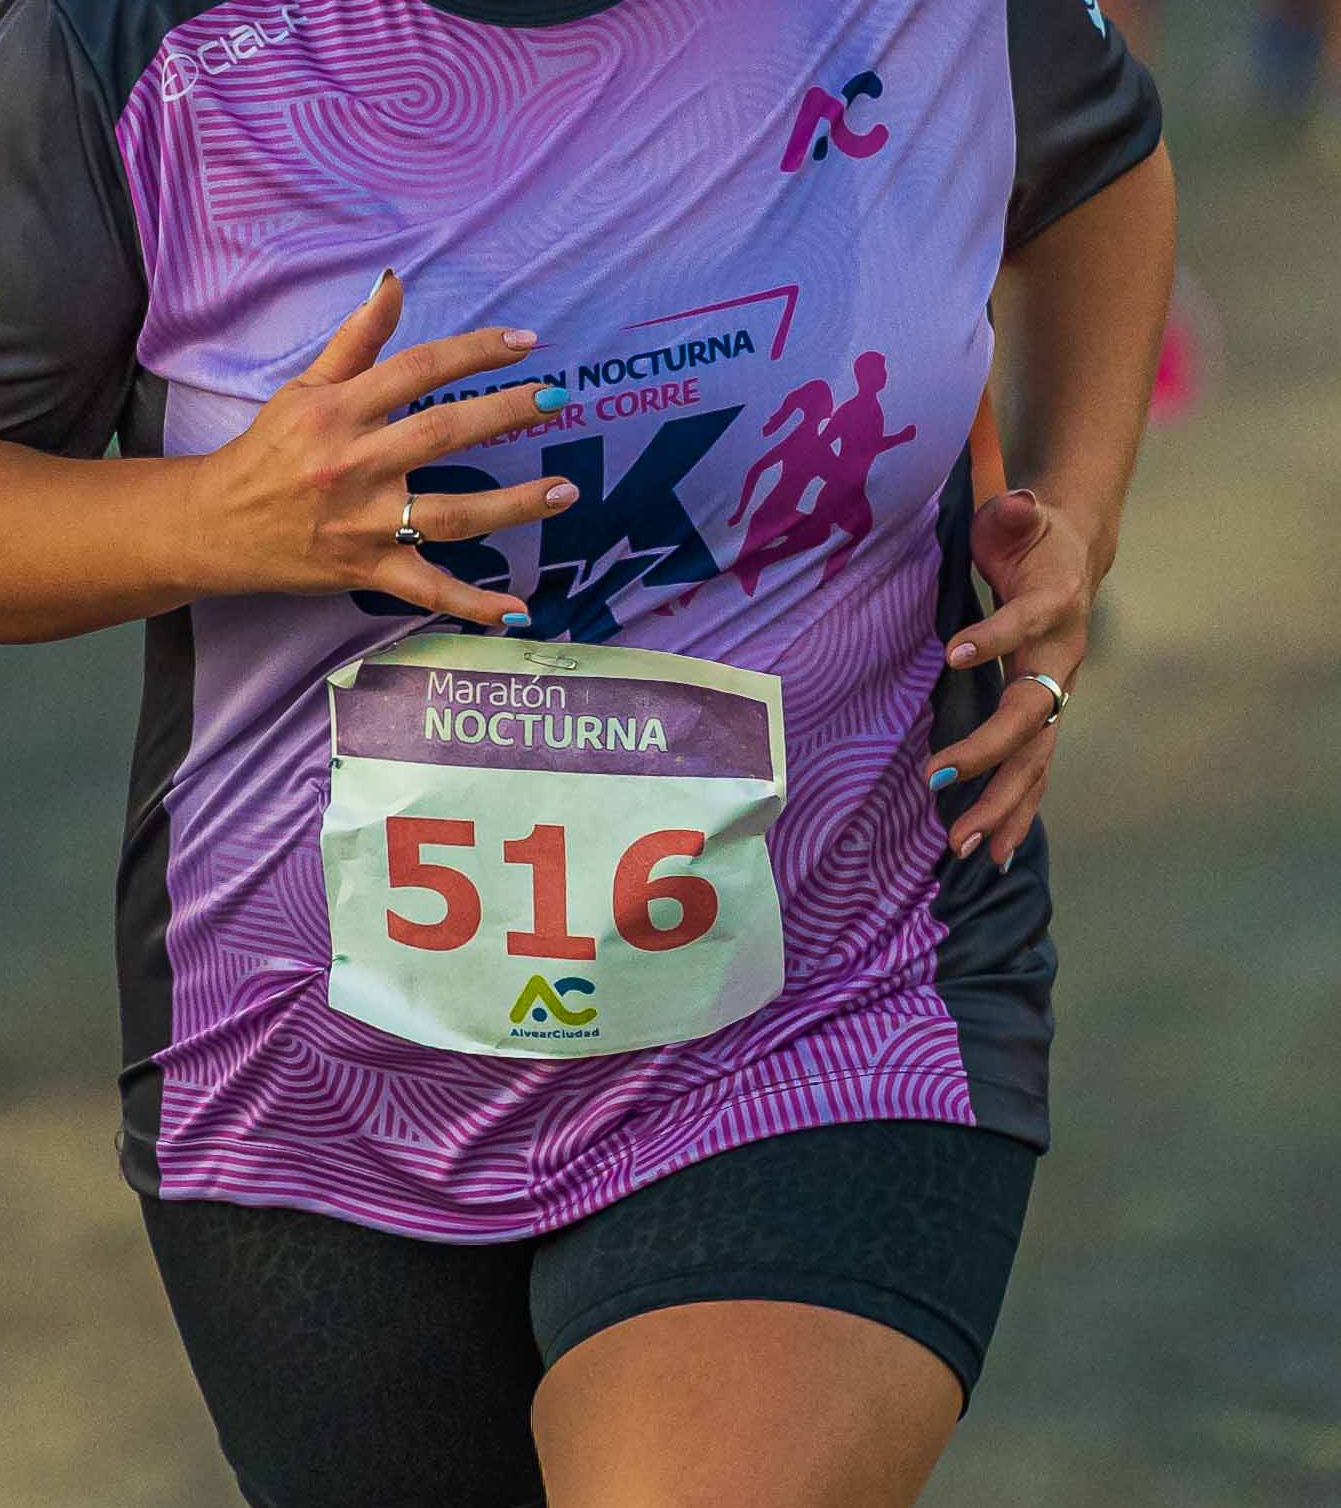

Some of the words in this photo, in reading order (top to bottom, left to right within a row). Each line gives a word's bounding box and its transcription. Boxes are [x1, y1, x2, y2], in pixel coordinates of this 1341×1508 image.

[408, 370, 567, 415] MARN
[577, 330, 756, 391] NOCTURNA
[464, 404, 586, 450] EAR
[595, 377, 701, 422] CORRE
[427, 672, 566, 708] Maratón
[424, 707, 669, 753] NOCTURNA
[386, 816, 719, 960] 516
[510, 1027, 600, 1039] AlvearCiudad
